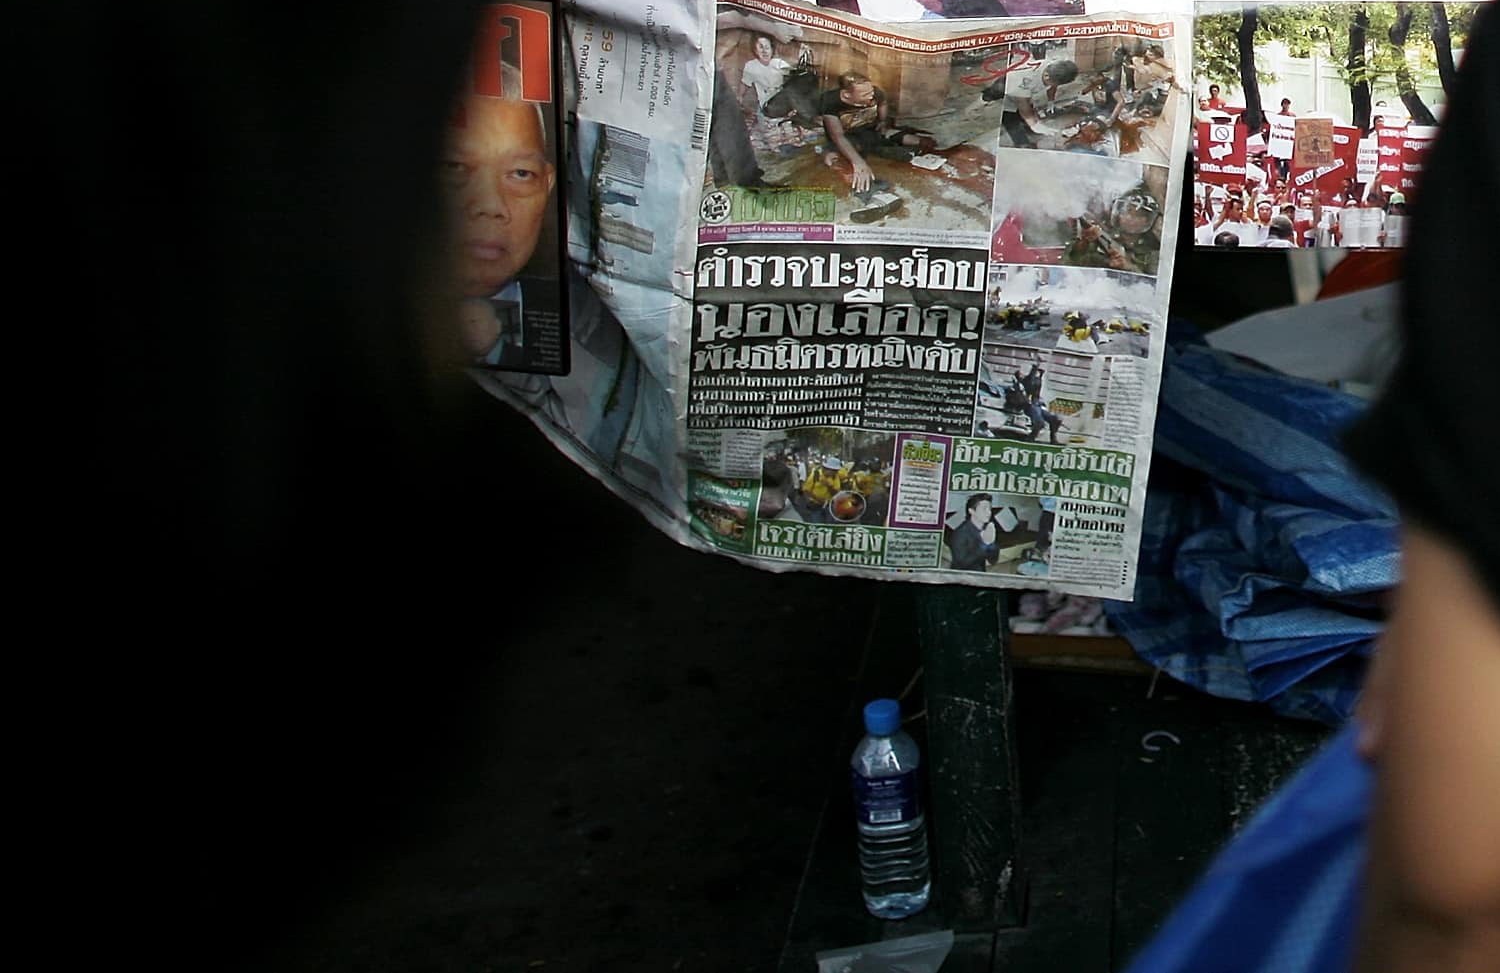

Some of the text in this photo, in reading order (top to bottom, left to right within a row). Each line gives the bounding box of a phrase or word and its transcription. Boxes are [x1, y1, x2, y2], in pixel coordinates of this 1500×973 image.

[696, 247, 986, 293] ตำรวจปะทะม็อบ
[697, 287, 980, 342] นองเลือด!
[693, 337, 978, 374] พันธมิตรหญิงดับ
